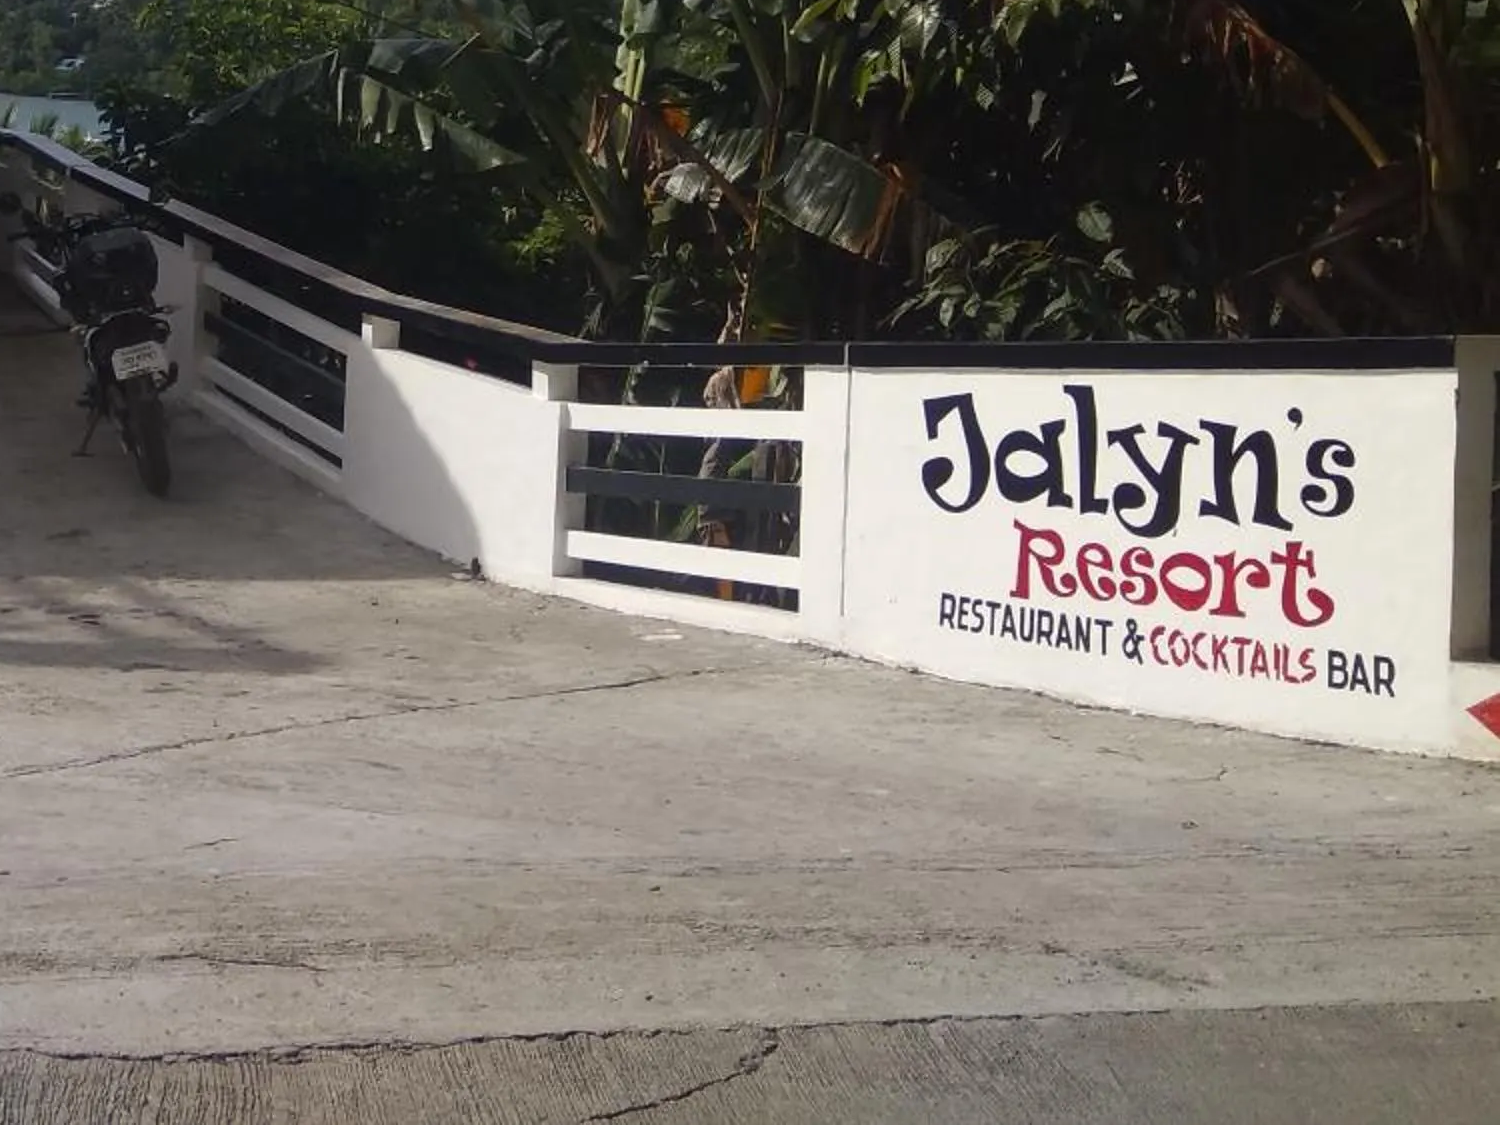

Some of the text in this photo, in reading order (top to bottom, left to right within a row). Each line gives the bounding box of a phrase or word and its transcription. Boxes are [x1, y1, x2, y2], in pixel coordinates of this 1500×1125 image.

[921, 384, 1357, 539] Jalyn's
[1009, 519, 1335, 628] Resort
[939, 592, 1396, 698] RESTAURANT & COCKTAILS BAR
